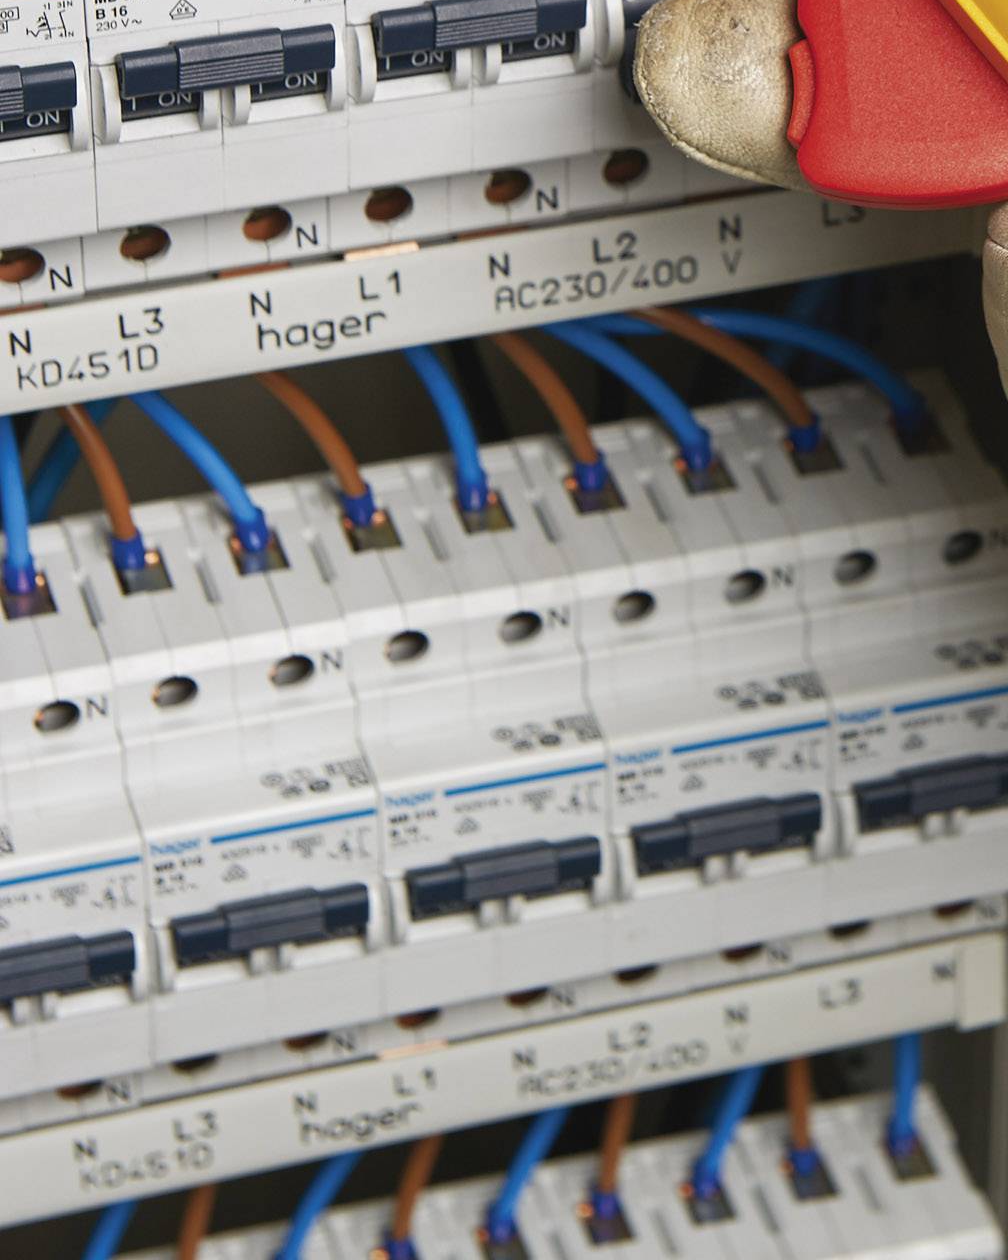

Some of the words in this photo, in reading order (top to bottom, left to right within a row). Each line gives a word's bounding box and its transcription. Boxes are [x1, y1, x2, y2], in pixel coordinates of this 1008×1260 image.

[95, 9, 105, 20] B
[111, 6, 128, 18] 16
[95, 21, 117, 32] 230
[533, 32, 566, 50] ON
[411, 51, 444, 67] ON
[284, 71, 318, 89] ON
[158, 92, 193, 107] ON
[26, 109, 60, 128] ON
[536, 187, 559, 211] N
[297, 224, 318, 248] N
[9, 330, 31, 356] N
[119, 308, 164, 339] L3
[250, 291, 272, 318] N
[489, 254, 510, 279] N
[592, 232, 637, 264] L2
[719, 215, 742, 243] N
[48, 266, 72, 291] N
[17, 344, 158, 391] KD451D
[257, 312, 386, 351] hager
[495, 257, 697, 312] AC230/400
[722, 249, 743, 275] V
[773, 567, 795, 587] N
[547, 607, 570, 629] N
[320, 651, 343, 671] N
[86, 697, 108, 717] N
[551, 987, 574, 1009] N
[332, 1033, 356, 1052] N
[74, 1137, 97, 1162] N
[173, 1110, 218, 1142] L3
[294, 1092, 317, 1114] N
[512, 1050, 535, 1072] N
[607, 1024, 651, 1053] L2
[725, 1006, 748, 1026] N
[819, 979, 863, 1009] L3
[933, 962, 956, 981] N
[105, 1077, 131, 1103] N
